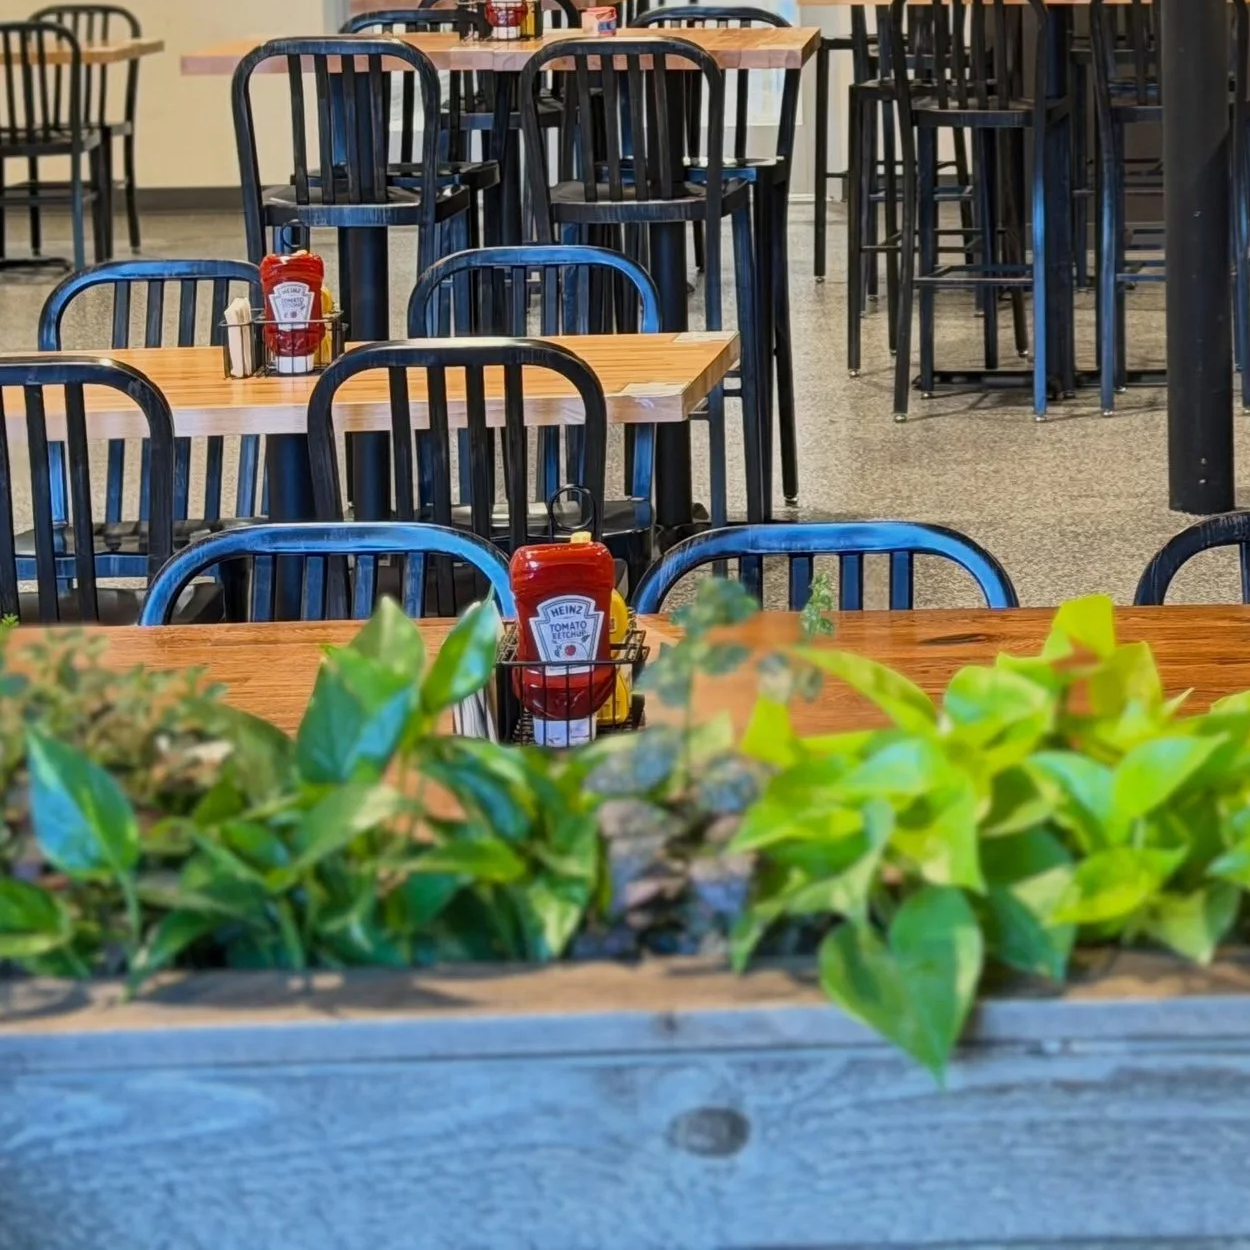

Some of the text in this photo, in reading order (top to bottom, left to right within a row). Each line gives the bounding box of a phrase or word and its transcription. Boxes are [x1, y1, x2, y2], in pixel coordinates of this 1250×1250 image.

[551, 605, 583, 617] HEINZ
[549, 620, 587, 632] TOMATO
[552, 630, 586, 639] KETCHUP
